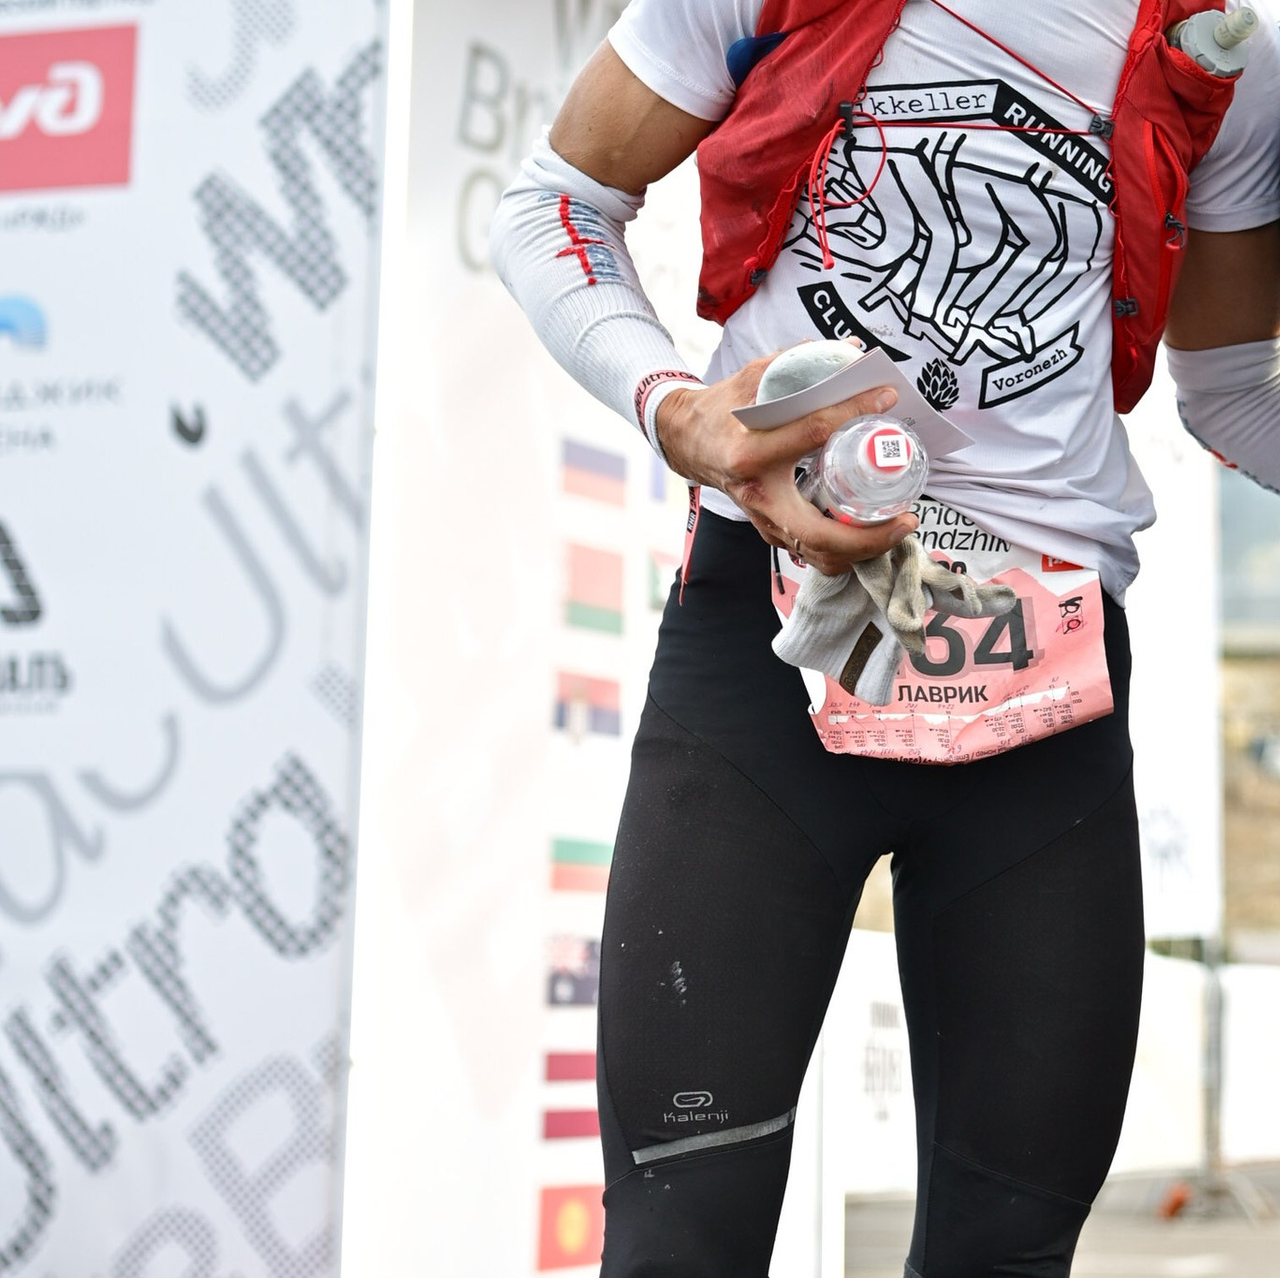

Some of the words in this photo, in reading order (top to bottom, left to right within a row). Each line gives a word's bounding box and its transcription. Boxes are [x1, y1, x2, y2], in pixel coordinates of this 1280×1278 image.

[856, 92, 987, 115] ikkeller
[1004, 102, 1114, 194] RUNNING
[992, 348, 1068, 390] Voronezh
[898, 684, 989, 704] ЛАВРИК
[664, 1109, 729, 1124] Kalenji
